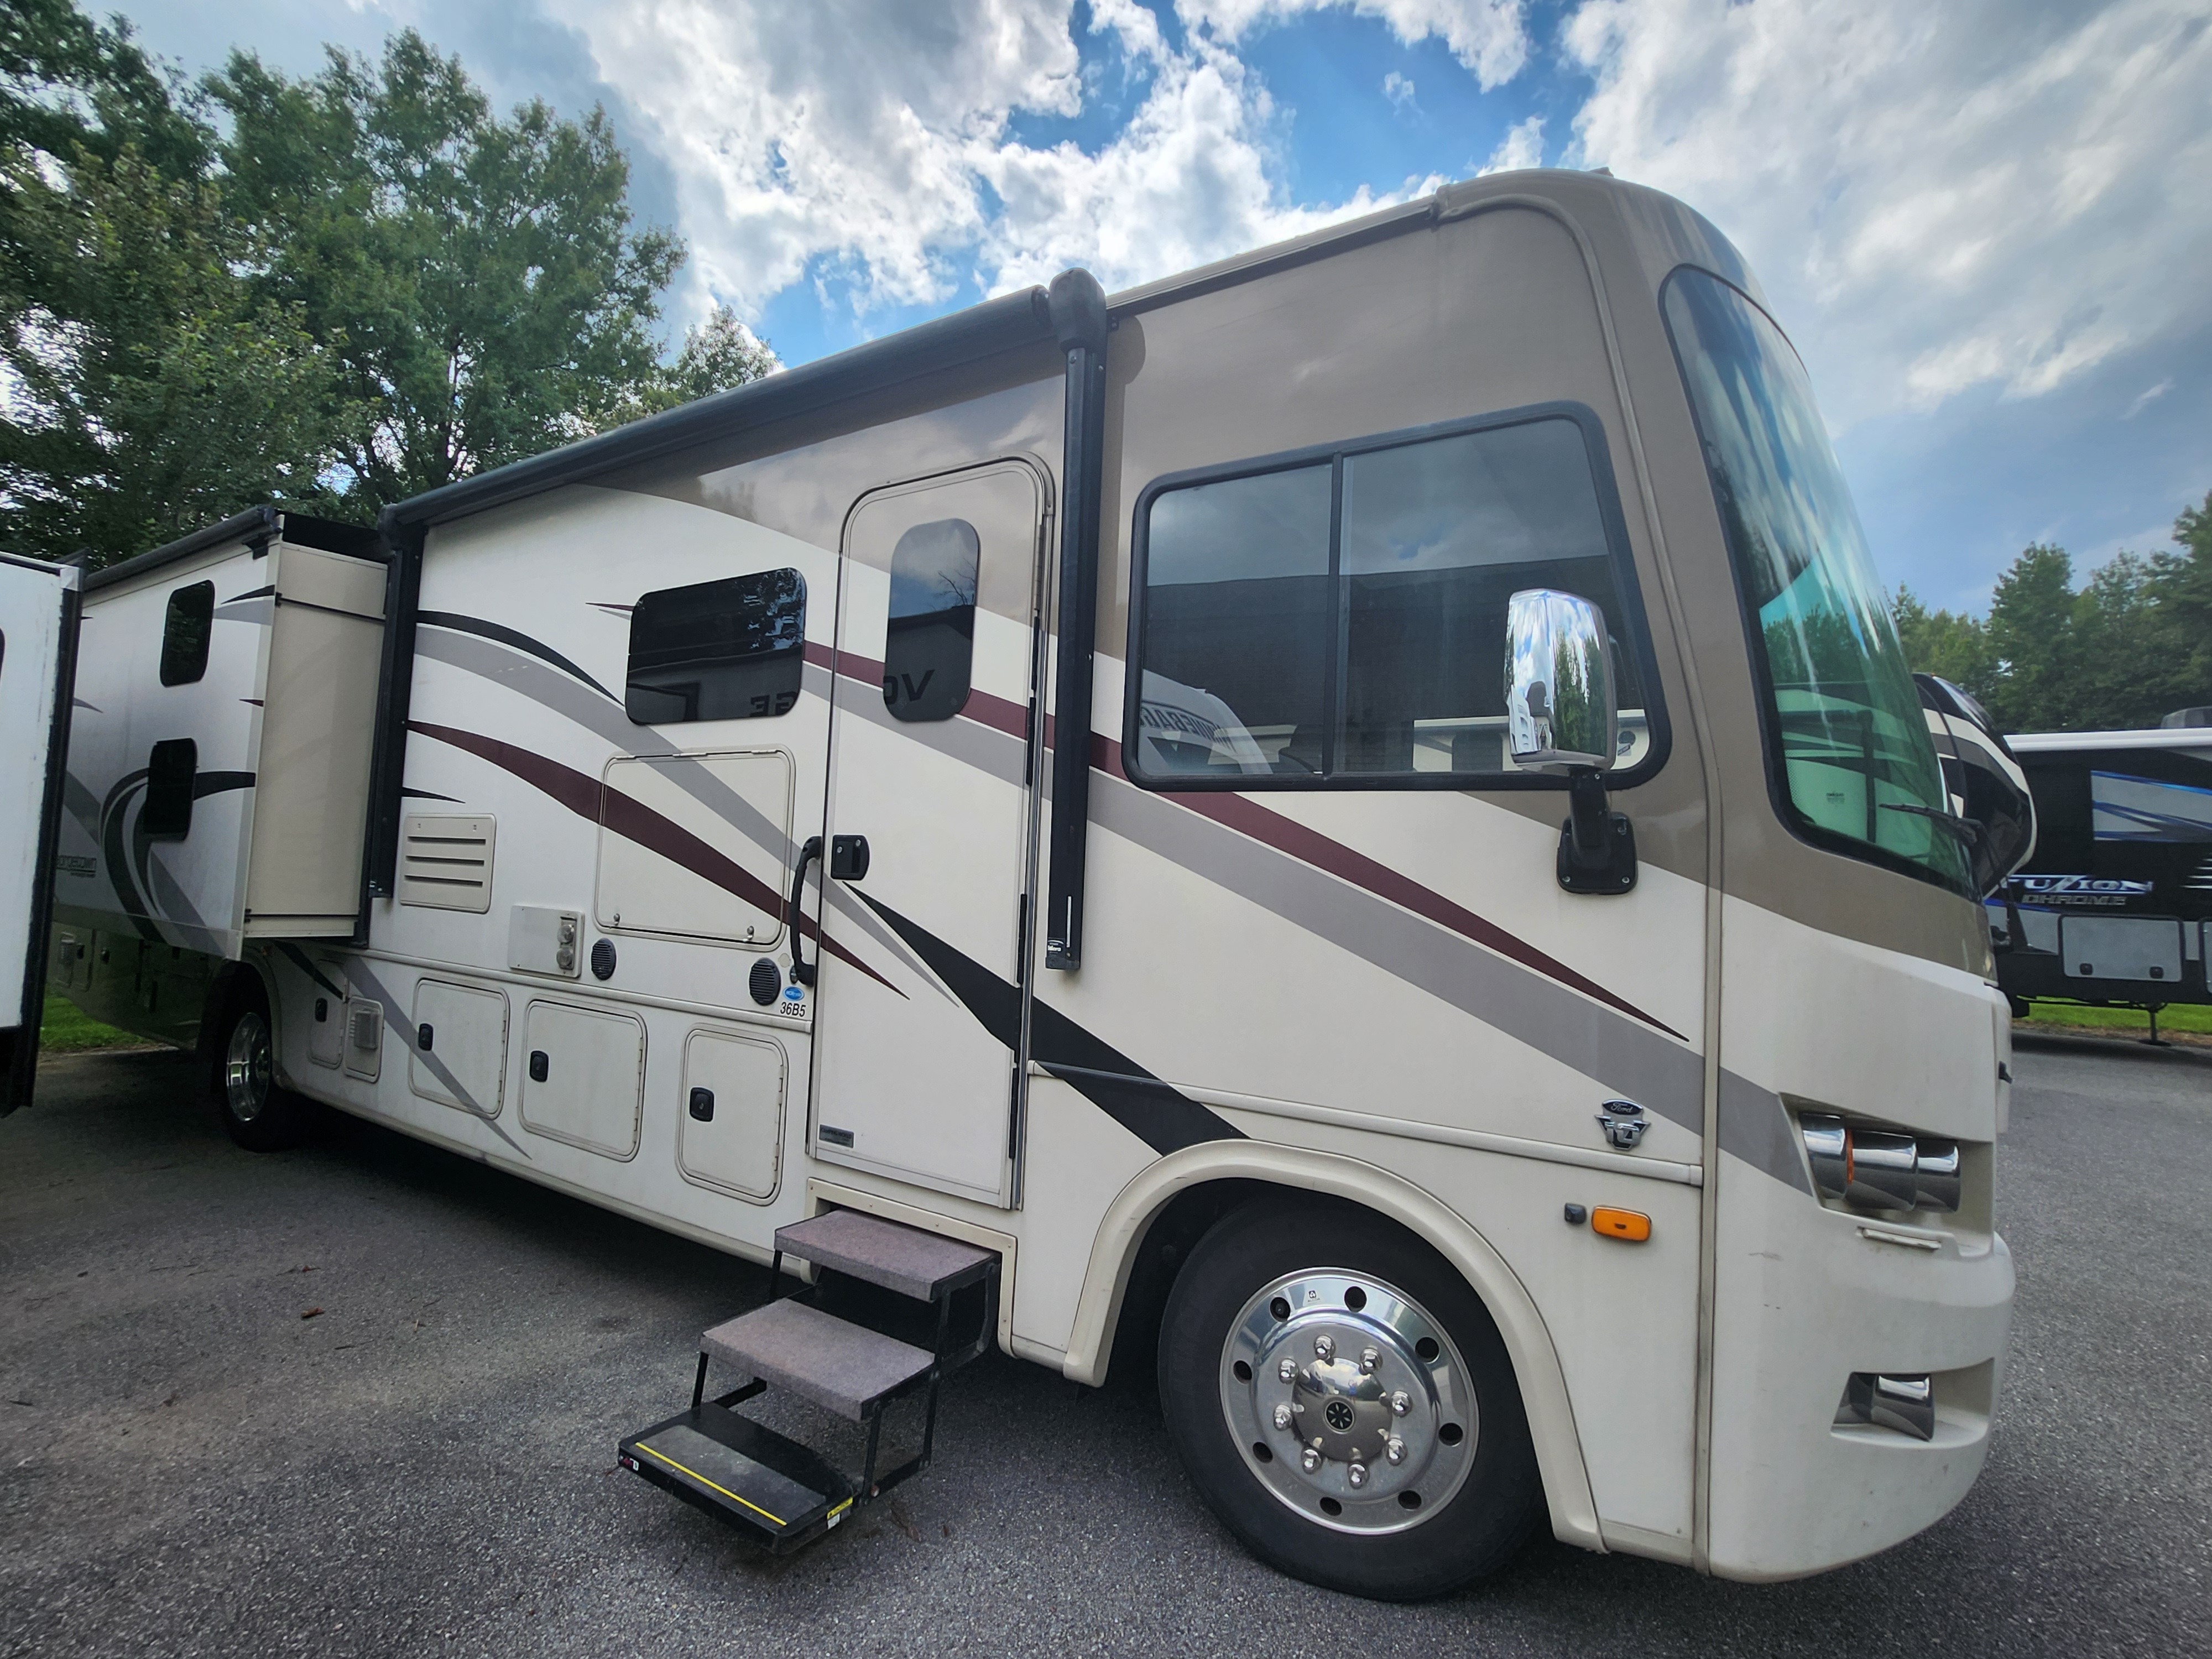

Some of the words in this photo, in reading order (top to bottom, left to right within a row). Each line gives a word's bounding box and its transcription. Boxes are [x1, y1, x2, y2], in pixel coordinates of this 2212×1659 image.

[2021, 894, 2127, 905] CHROME
[780, 1001, 806, 1018] 36B5
[1610, 1102, 1634, 1113] Ford
